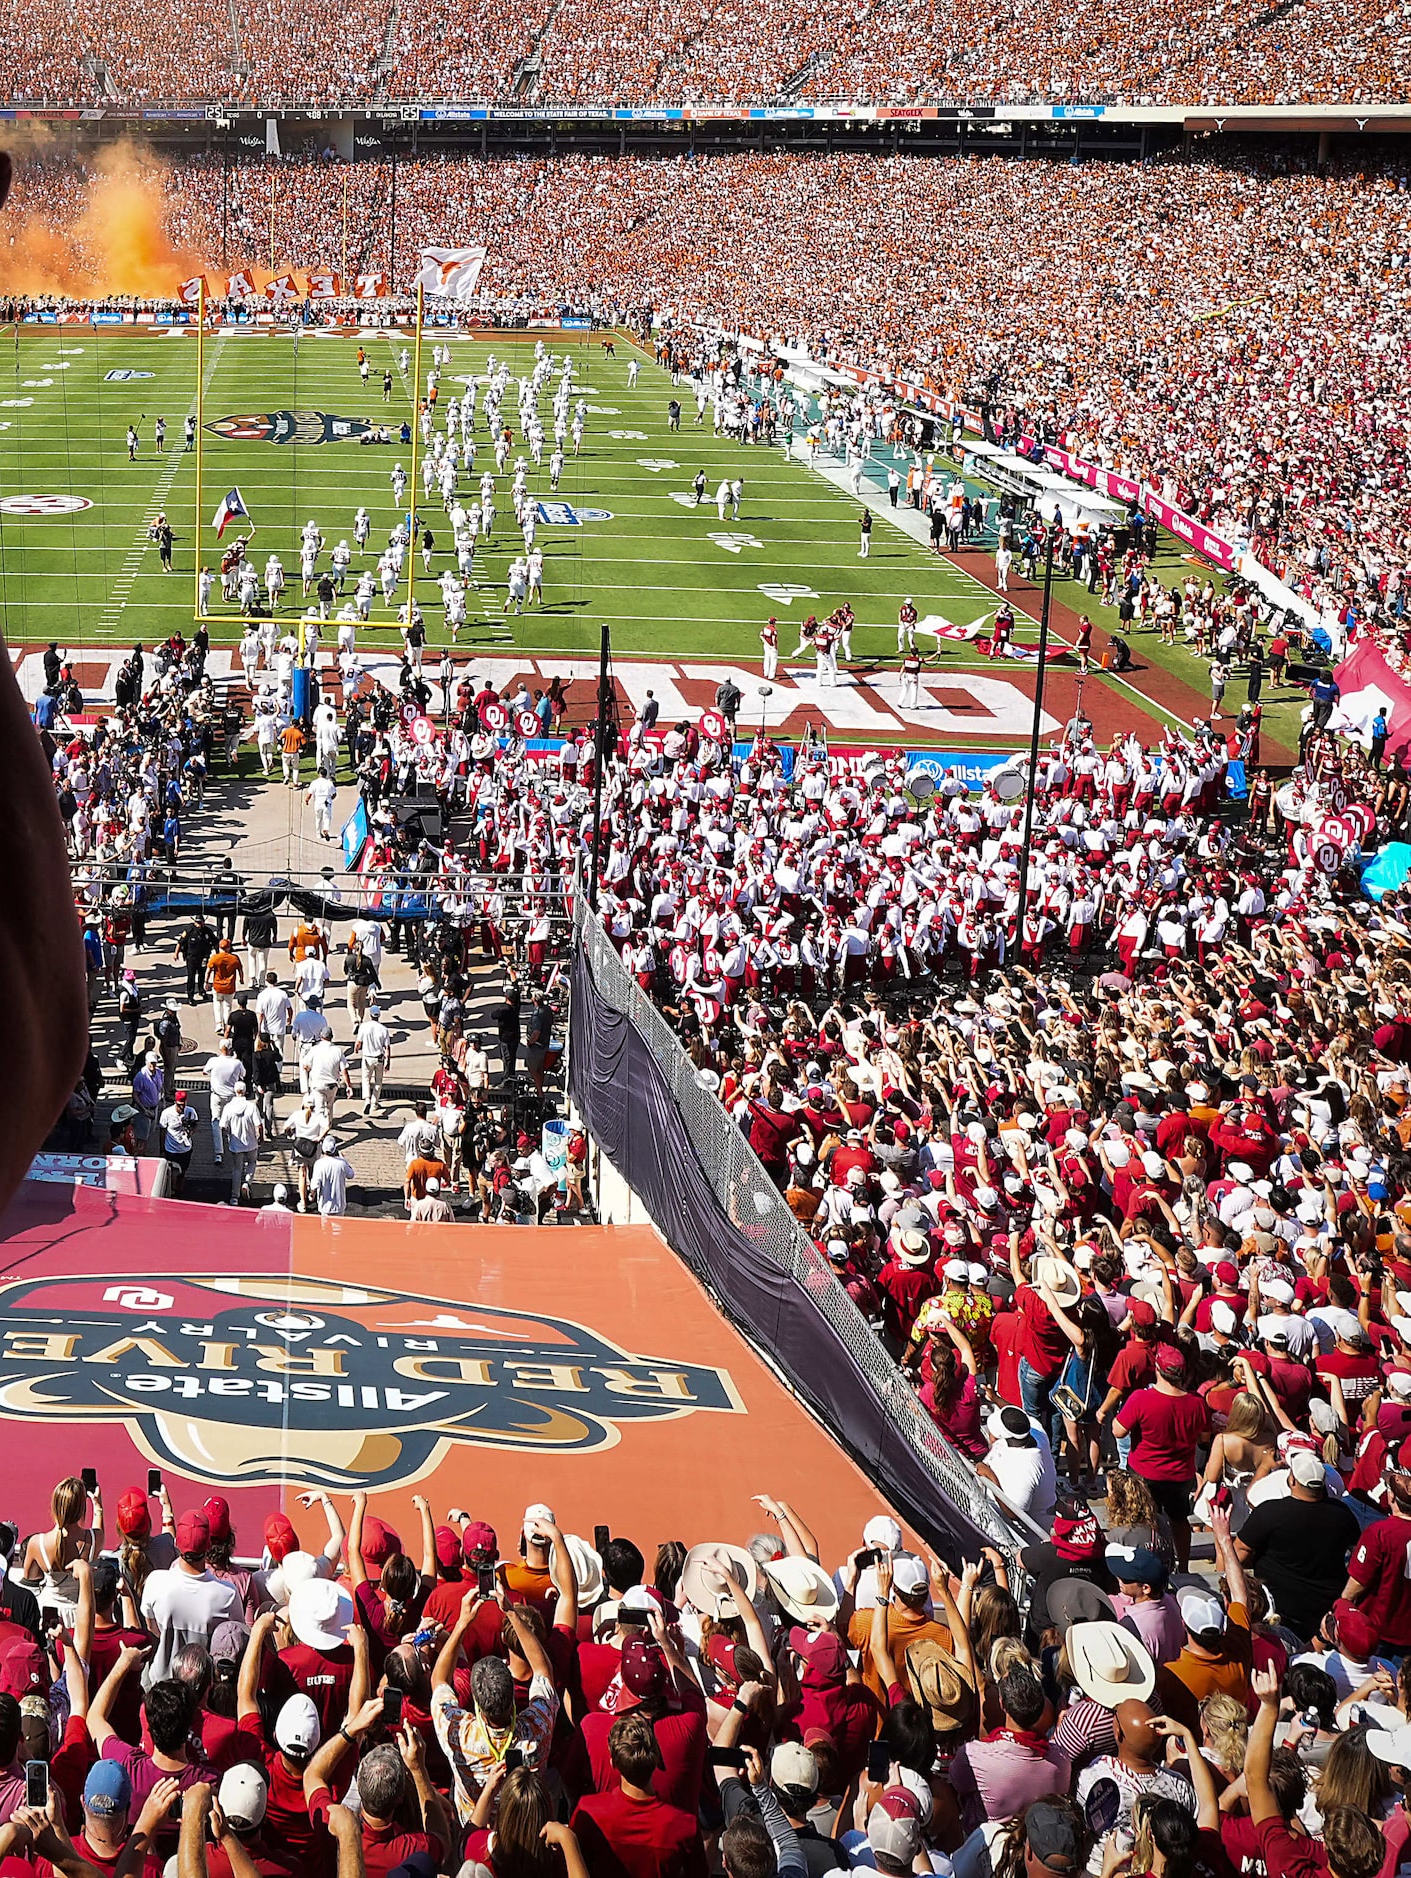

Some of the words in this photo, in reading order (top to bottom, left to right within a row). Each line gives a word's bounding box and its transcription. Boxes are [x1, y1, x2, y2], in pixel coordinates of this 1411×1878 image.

[207, 107, 221, 118] 25
[256, 111, 263, 119] 0
[306, 111, 321, 119] 4:08
[365, 111, 371, 119] 0
[403, 107, 417, 118] 25
[890, 109, 924, 117] SEATGEEK
[147, 326, 474, 340] TEXAS
[486, 706, 505, 729] OU
[520, 712, 538, 736] OU
[413, 718, 431, 743] OU
[703, 717, 722, 739] OU
[1325, 819, 1349, 850] OU
[1319, 845, 1339, 873] OU
[32, 1154, 139, 1171] HORN
[101, 1285, 176, 1310] OU
[131, 1320, 439, 1351] RIVALRY
[393, 1357, 699, 1401] RED
[124, 1373, 451, 1413] Allstate
[1357, 1545, 1367, 1564] 6
[30, 1672, 40, 1684] OU
